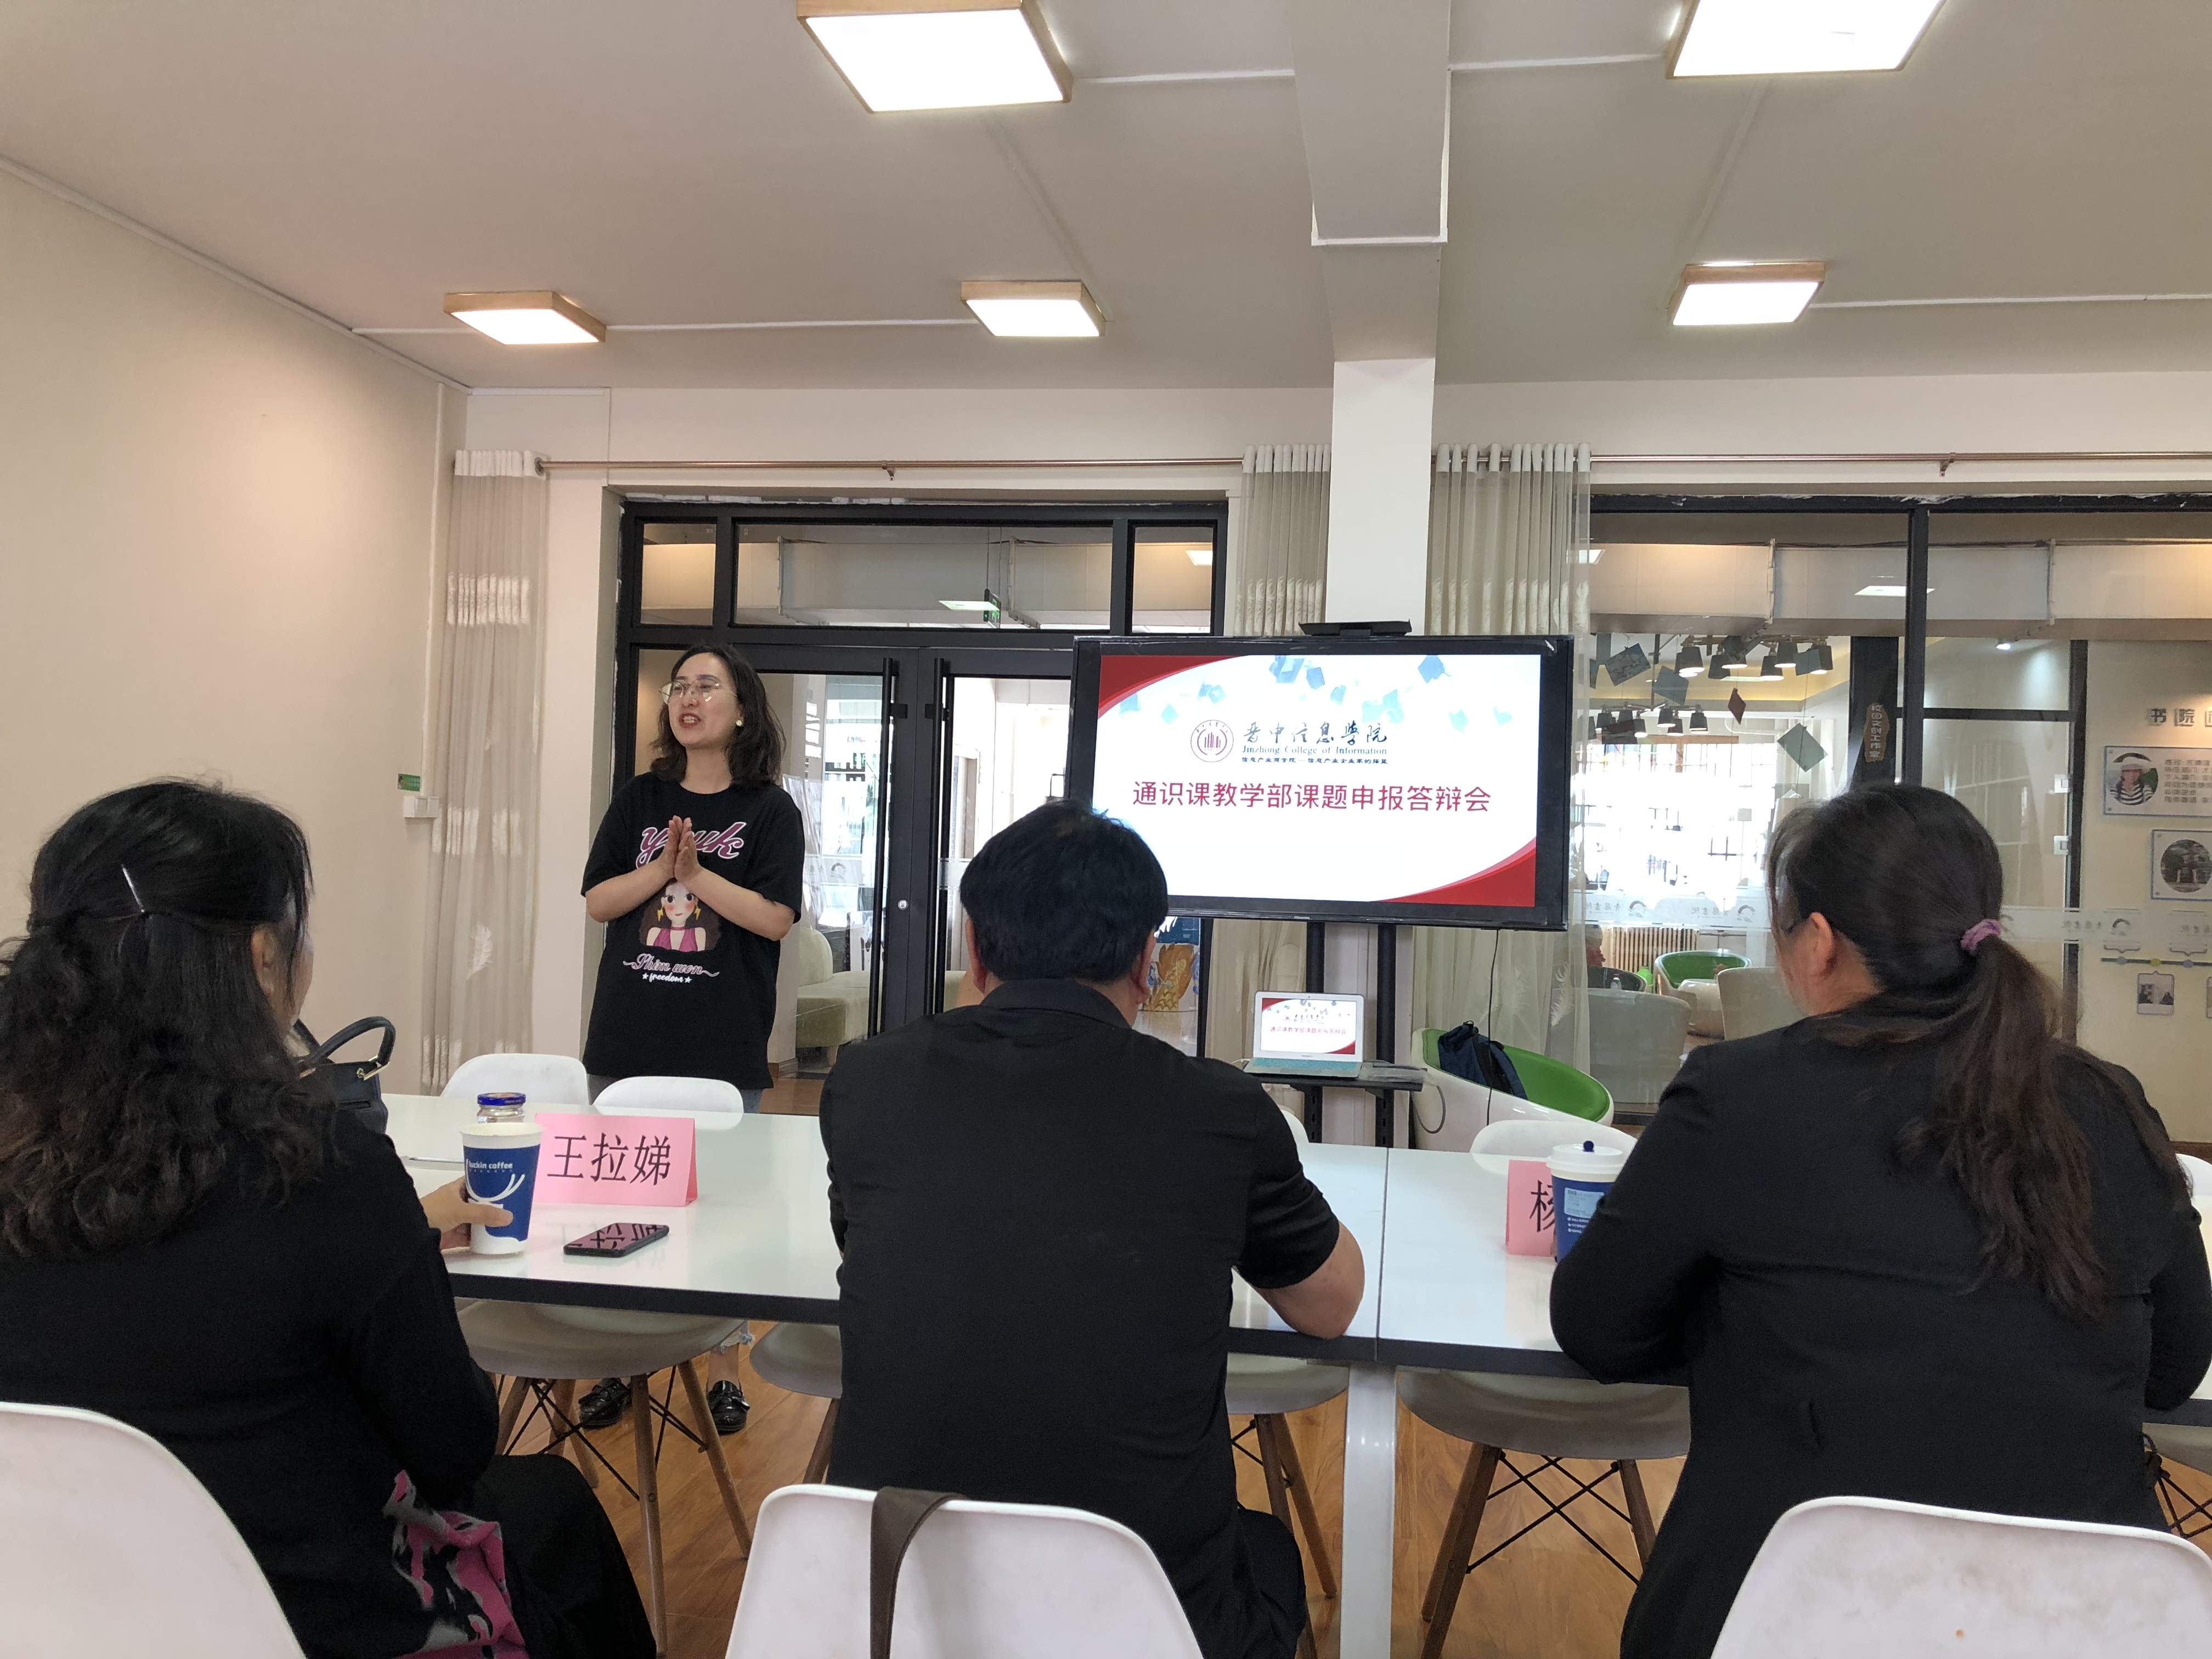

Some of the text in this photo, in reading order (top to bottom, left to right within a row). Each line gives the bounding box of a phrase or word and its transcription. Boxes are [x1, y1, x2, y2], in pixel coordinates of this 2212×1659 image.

[1243, 746, 1280, 755] Jinzhong
[1285, 746, 1317, 755] College
[1336, 746, 1387, 754] Information
[1133, 781, 1491, 812] 通识课教学部课题申报答辩会
[649, 972, 684, 983] freedom
[547, 1132, 671, 1186] 王拉娣
